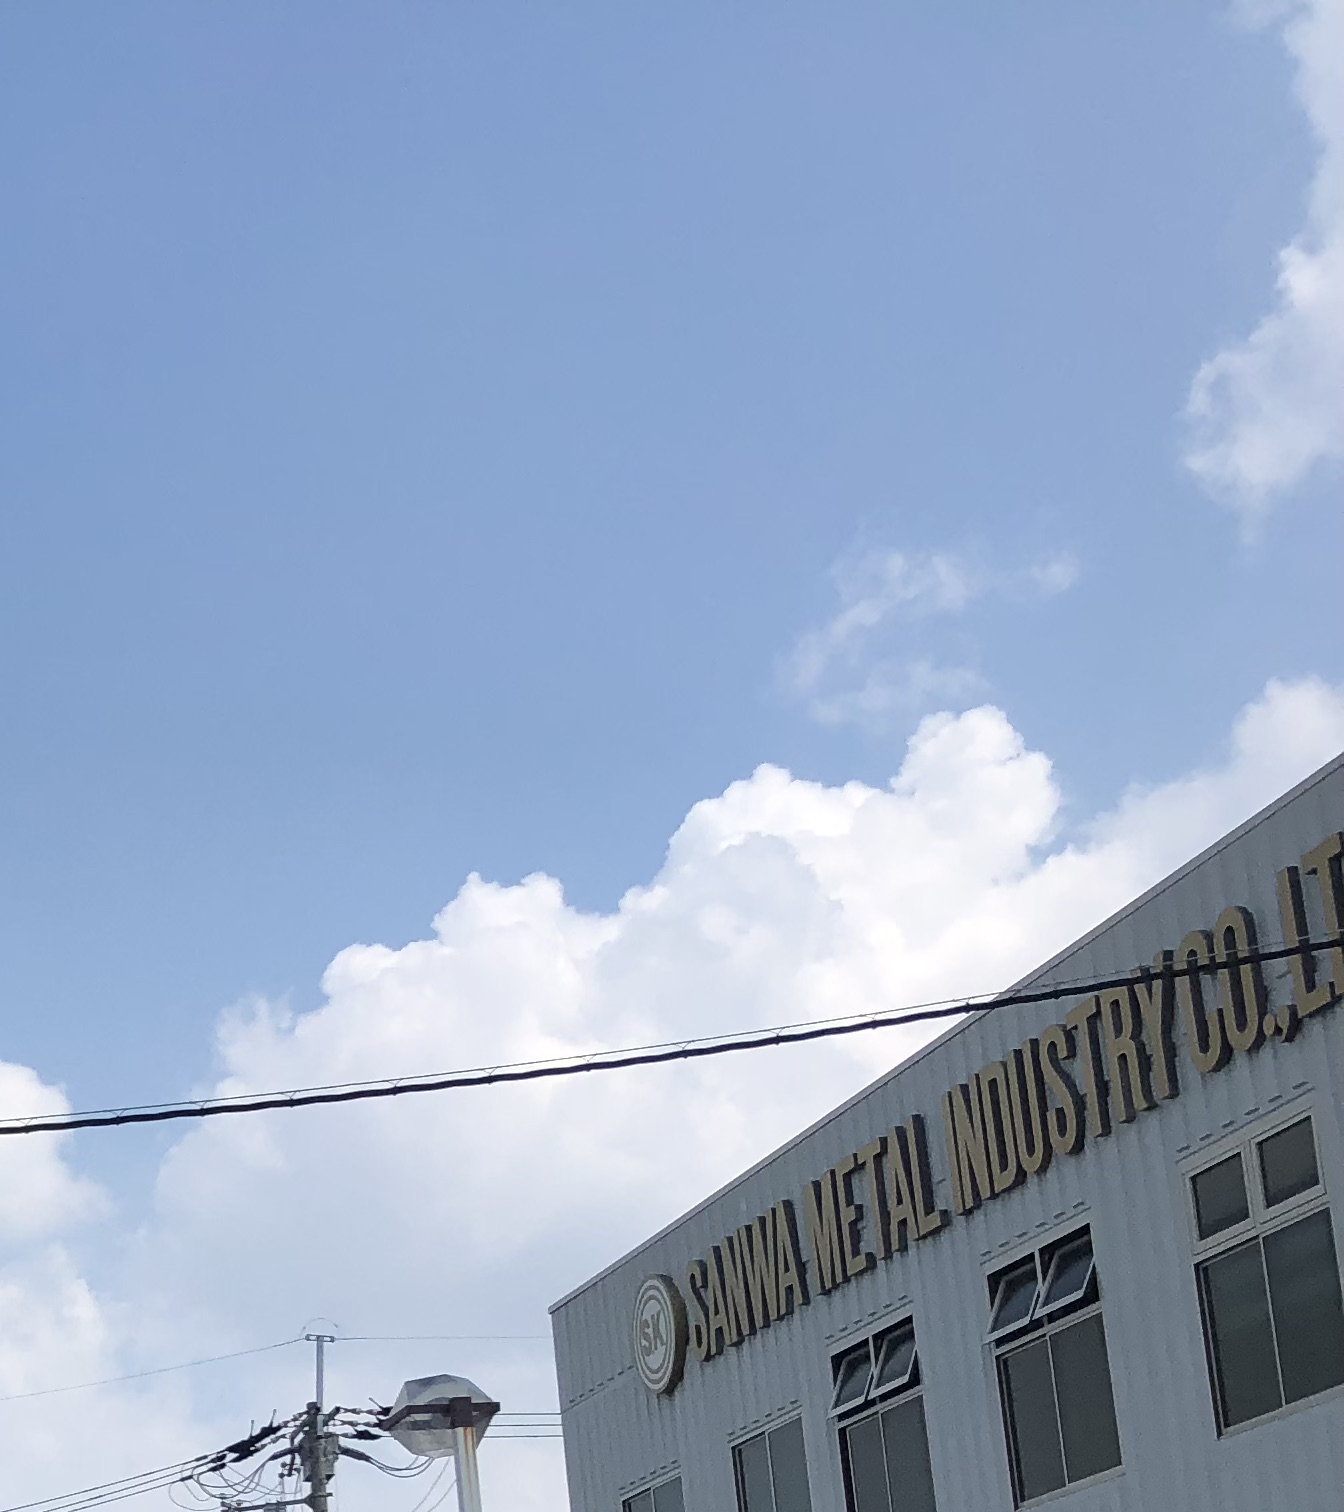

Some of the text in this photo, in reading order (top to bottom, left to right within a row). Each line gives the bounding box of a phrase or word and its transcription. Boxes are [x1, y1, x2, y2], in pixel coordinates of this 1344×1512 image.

[686, 1200, 809, 1361] SANWA
[803, 1115, 946, 1294] METAL
[942, 950, 1178, 1216] INDUSTRY
[641, 1310, 668, 1357] SK
